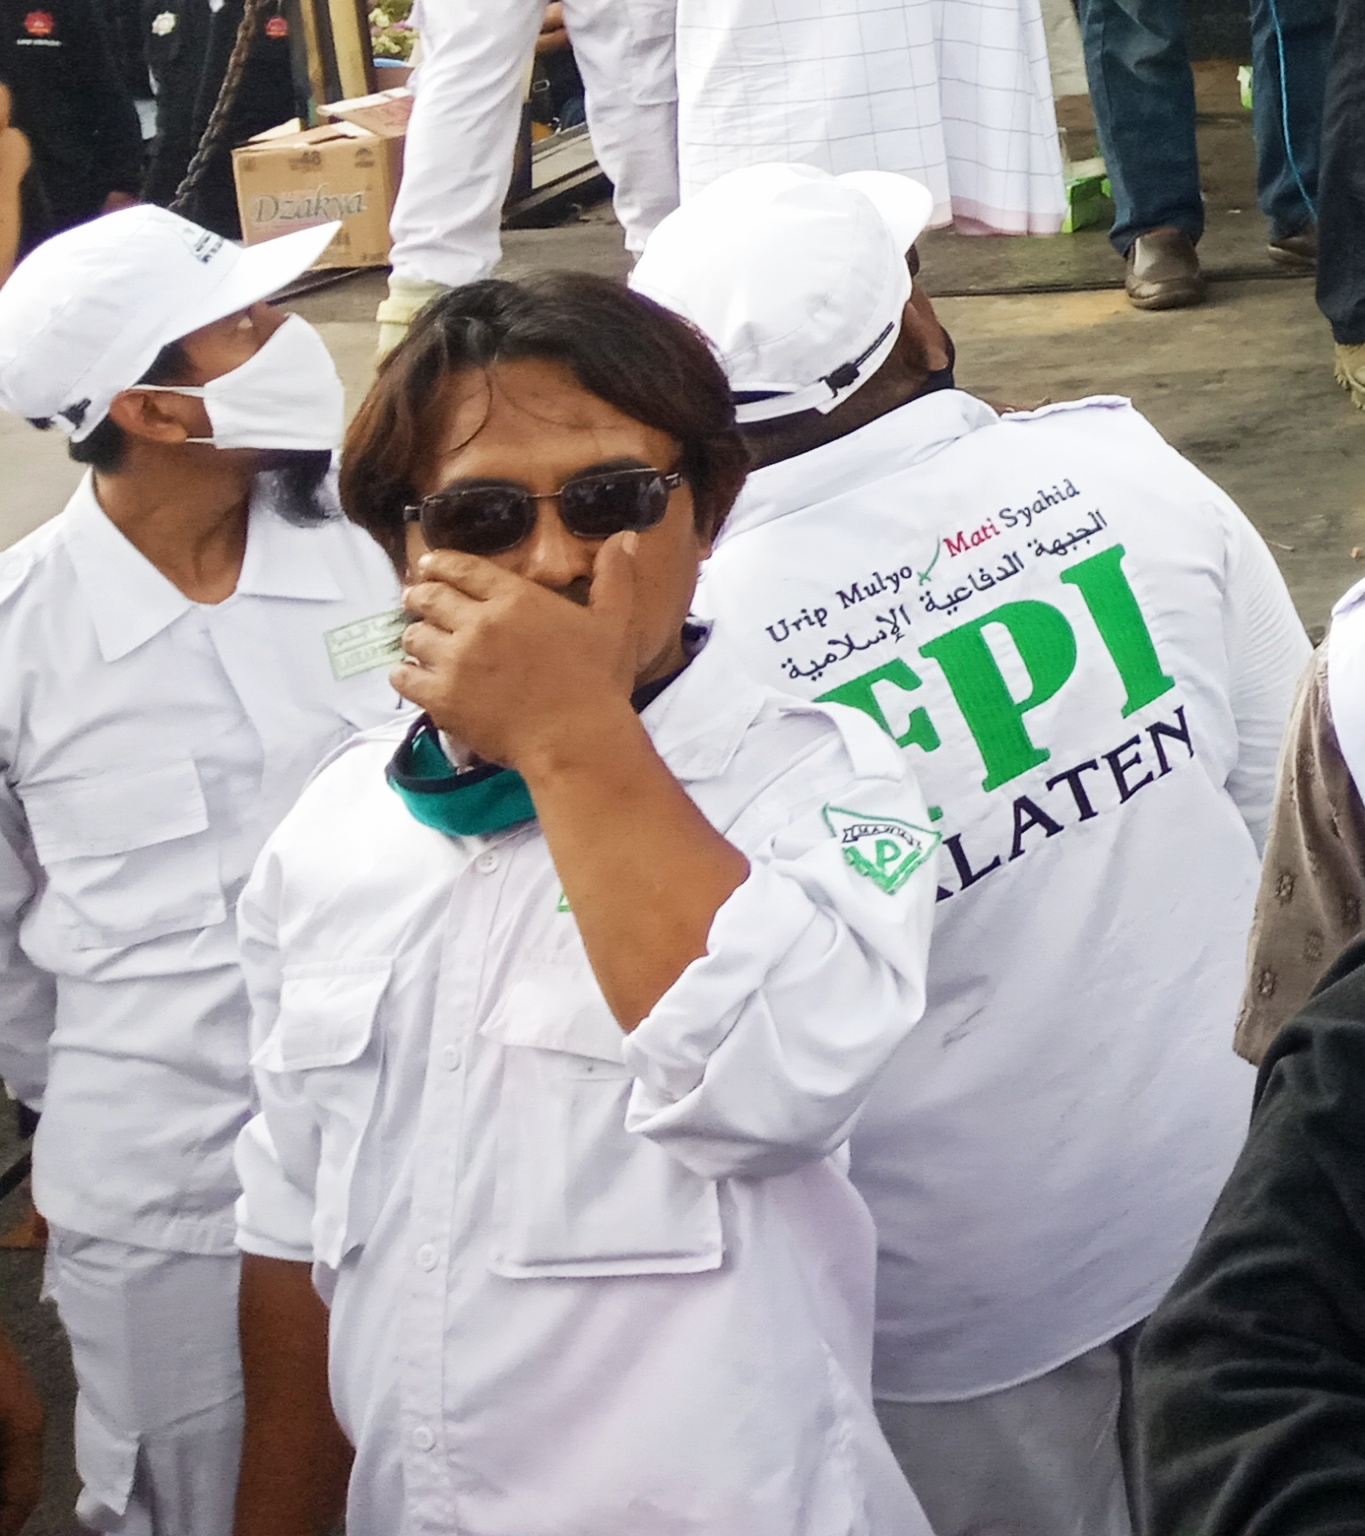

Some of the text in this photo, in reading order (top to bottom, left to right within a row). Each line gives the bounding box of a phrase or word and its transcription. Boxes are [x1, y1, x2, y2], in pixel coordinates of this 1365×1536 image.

[256, 183, 367, 223] Dzakya
[765, 478, 1081, 645] Urip Mulyo Mati Syahid
[781, 509, 1109, 681] الجبهة الدفاعية الإسلامية
[935, 705, 1196, 903] LATEN
